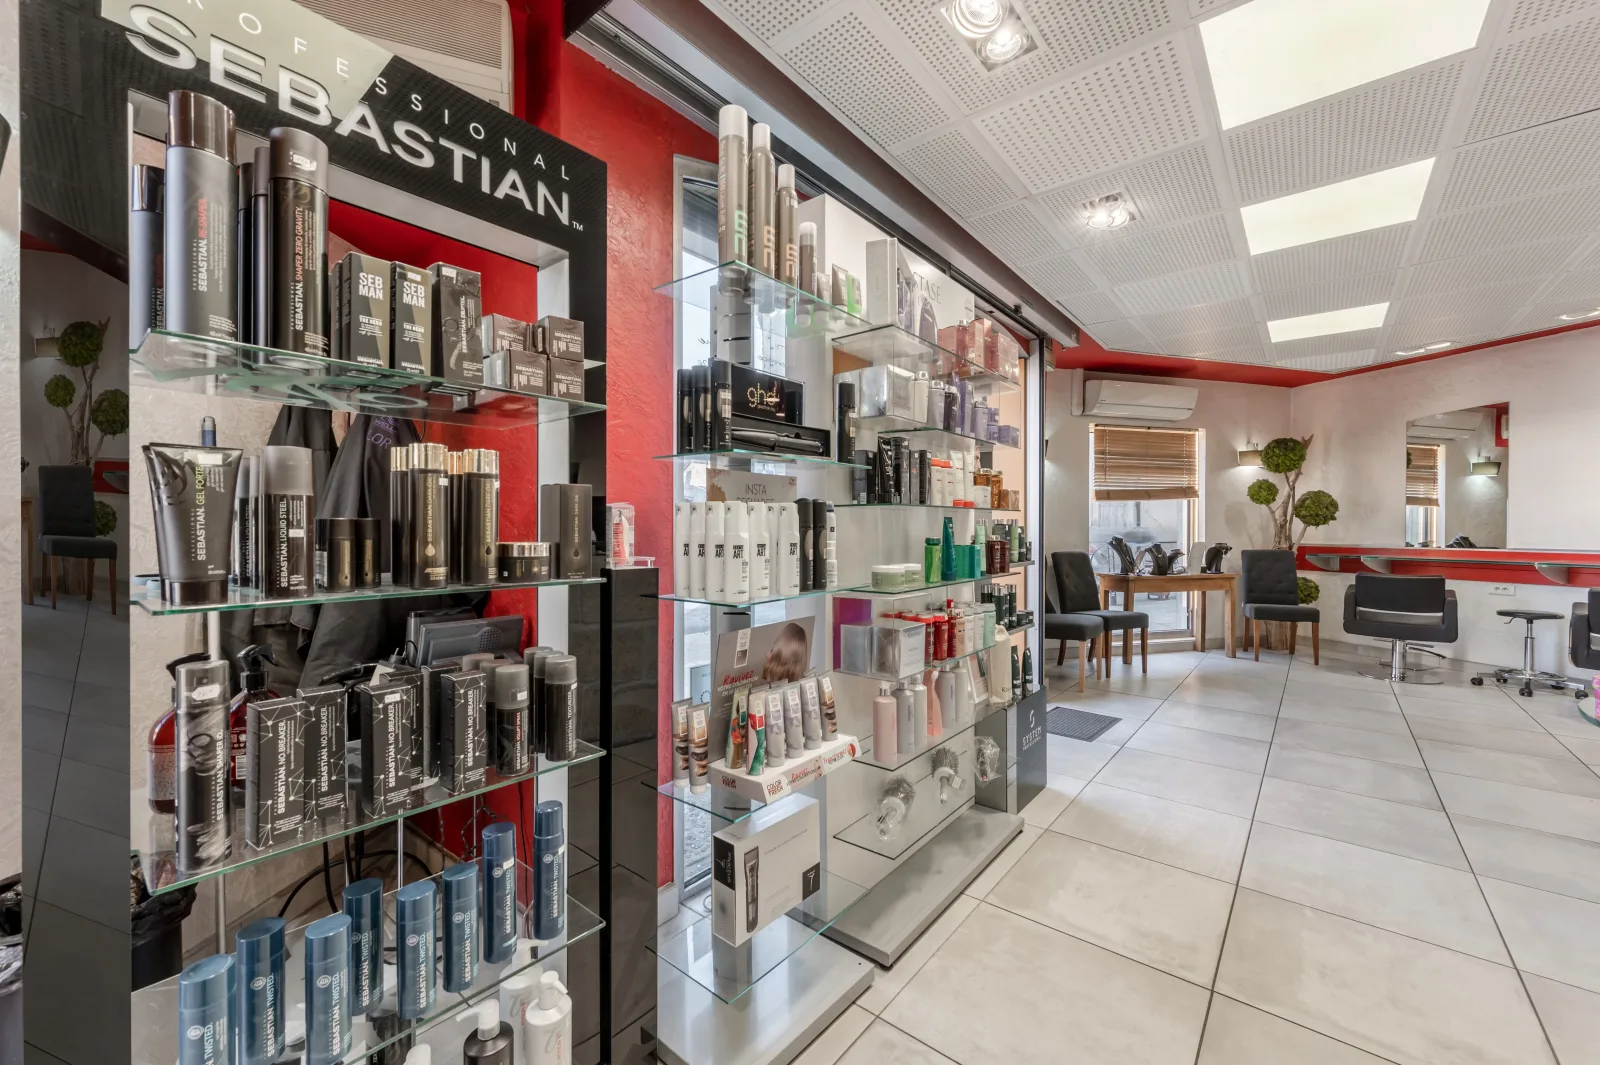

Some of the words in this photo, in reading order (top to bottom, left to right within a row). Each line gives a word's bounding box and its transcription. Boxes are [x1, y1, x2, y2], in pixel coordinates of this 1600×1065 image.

[187, 0, 570, 181] OFESSIONAL
[125, 3, 569, 226] SEBASTIAN
[295, 236, 304, 254] ZERO
[295, 254, 304, 281] SHAPER
[359, 272, 383, 289] SEB
[359, 284, 384, 300] MAN
[403, 281, 425, 298] SEB
[402, 292, 426, 308] MAN
[747, 380, 777, 408] ghd
[196, 490, 205, 506] GEL
[745, 483, 767, 496] INSTA
[279, 519, 287, 541] LIQUID
[723, 670, 754, 686] Ravivez
[1022, 725, 1042, 746] SYSTEM
[216, 740, 224, 768] SHAPER
[766, 779, 782, 790] COLOR
